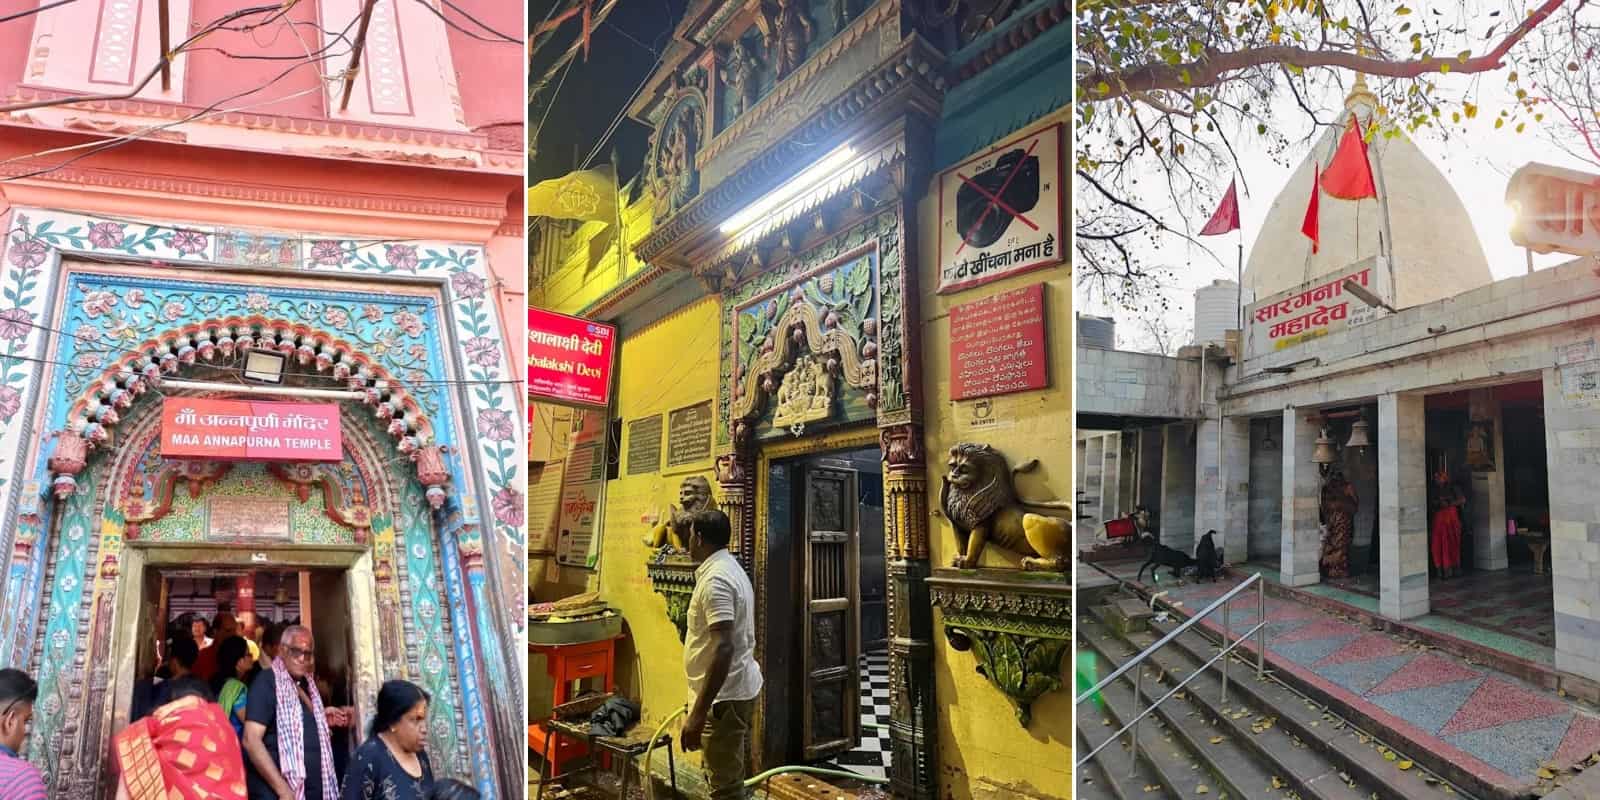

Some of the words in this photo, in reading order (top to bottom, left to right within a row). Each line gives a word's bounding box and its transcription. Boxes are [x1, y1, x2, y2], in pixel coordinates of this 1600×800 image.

[970, 251, 1012, 275] खींचना
[1014, 241, 1040, 262] मना
[1042, 233, 1055, 257] है
[1269, 302, 1349, 339] महादेव
[528, 330, 579, 351] शालाक्षी
[581, 336, 602, 356] देवी
[528, 354, 574, 374] shalakshi
[175, 408, 196, 426] माँ
[282, 413, 329, 431] मंदिर
[171, 434, 200, 446] MAA
[203, 434, 281, 448] ANNAPURNA
[284, 438, 332, 450] TEMPLE
